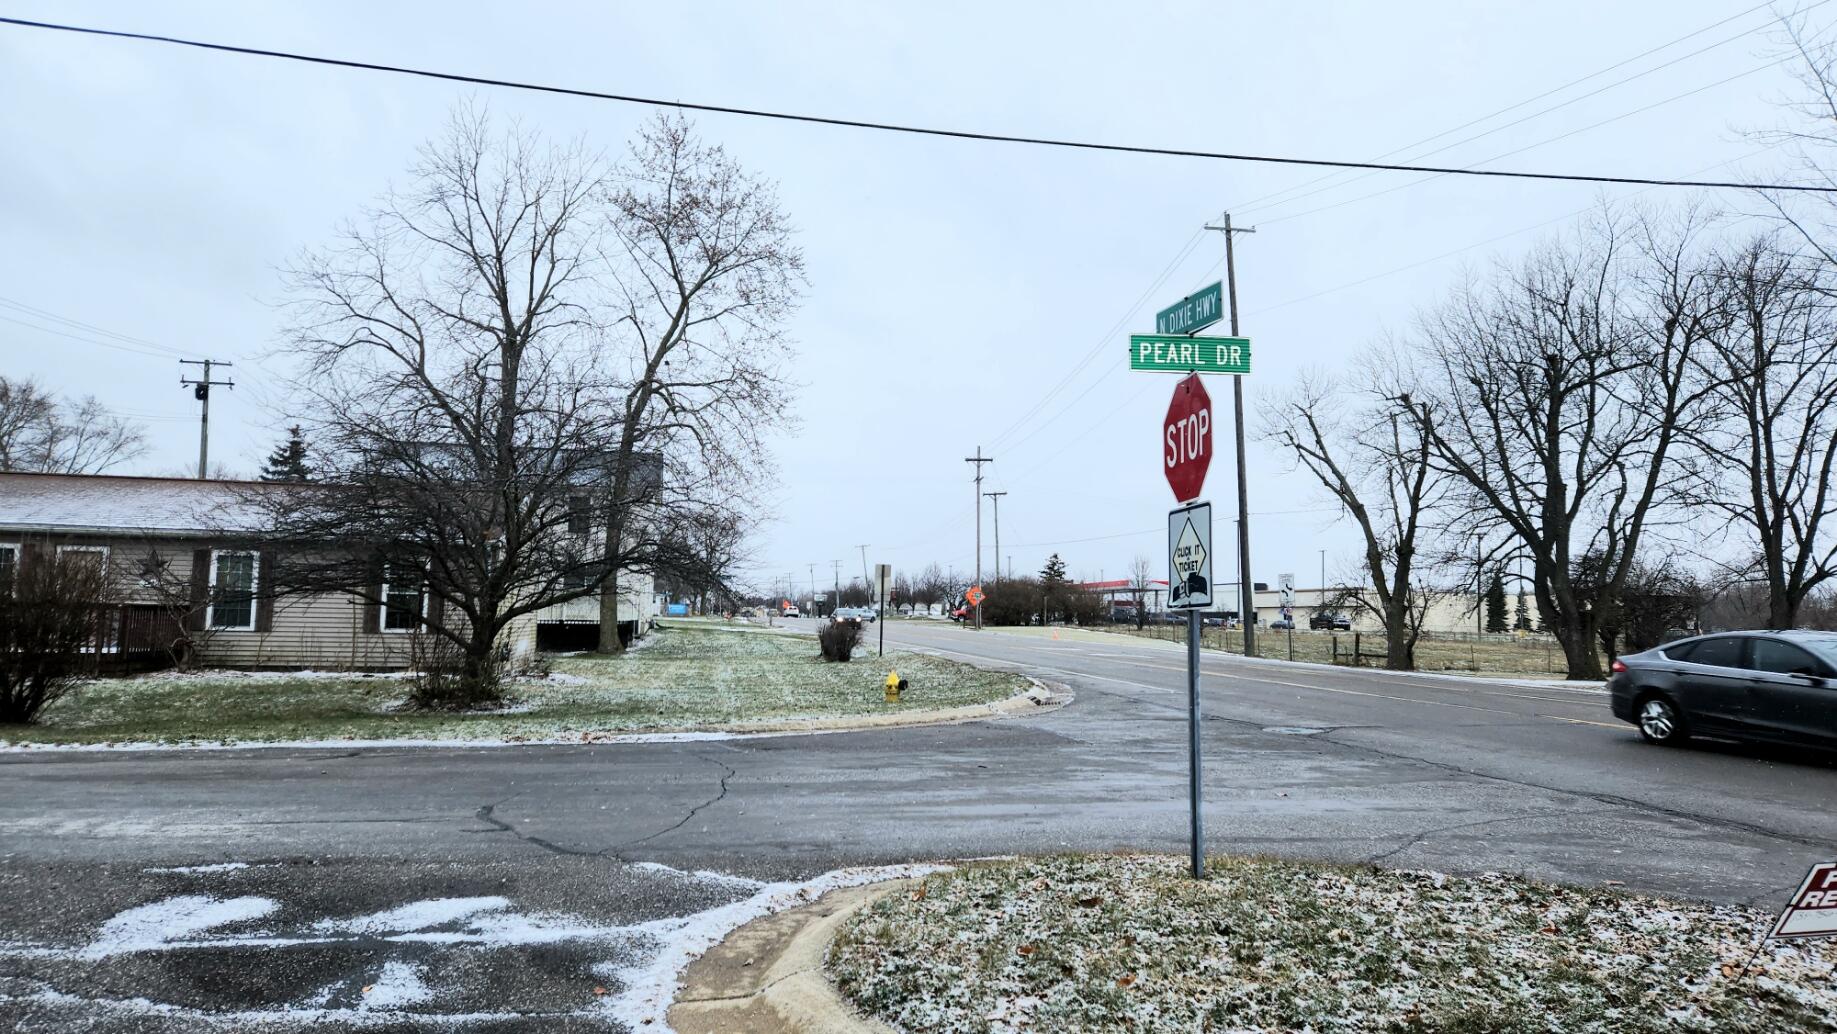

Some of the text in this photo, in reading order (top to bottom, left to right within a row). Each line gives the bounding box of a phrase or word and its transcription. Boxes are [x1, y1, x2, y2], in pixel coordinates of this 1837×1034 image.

[1160, 291, 1217, 334] N DIXIE HWY
[1139, 342, 1242, 366] PEARL DR
[1166, 408, 1209, 468] STOP
[1177, 544, 1201, 558] CLICK IT
[1179, 560, 1199, 573] TICKET
